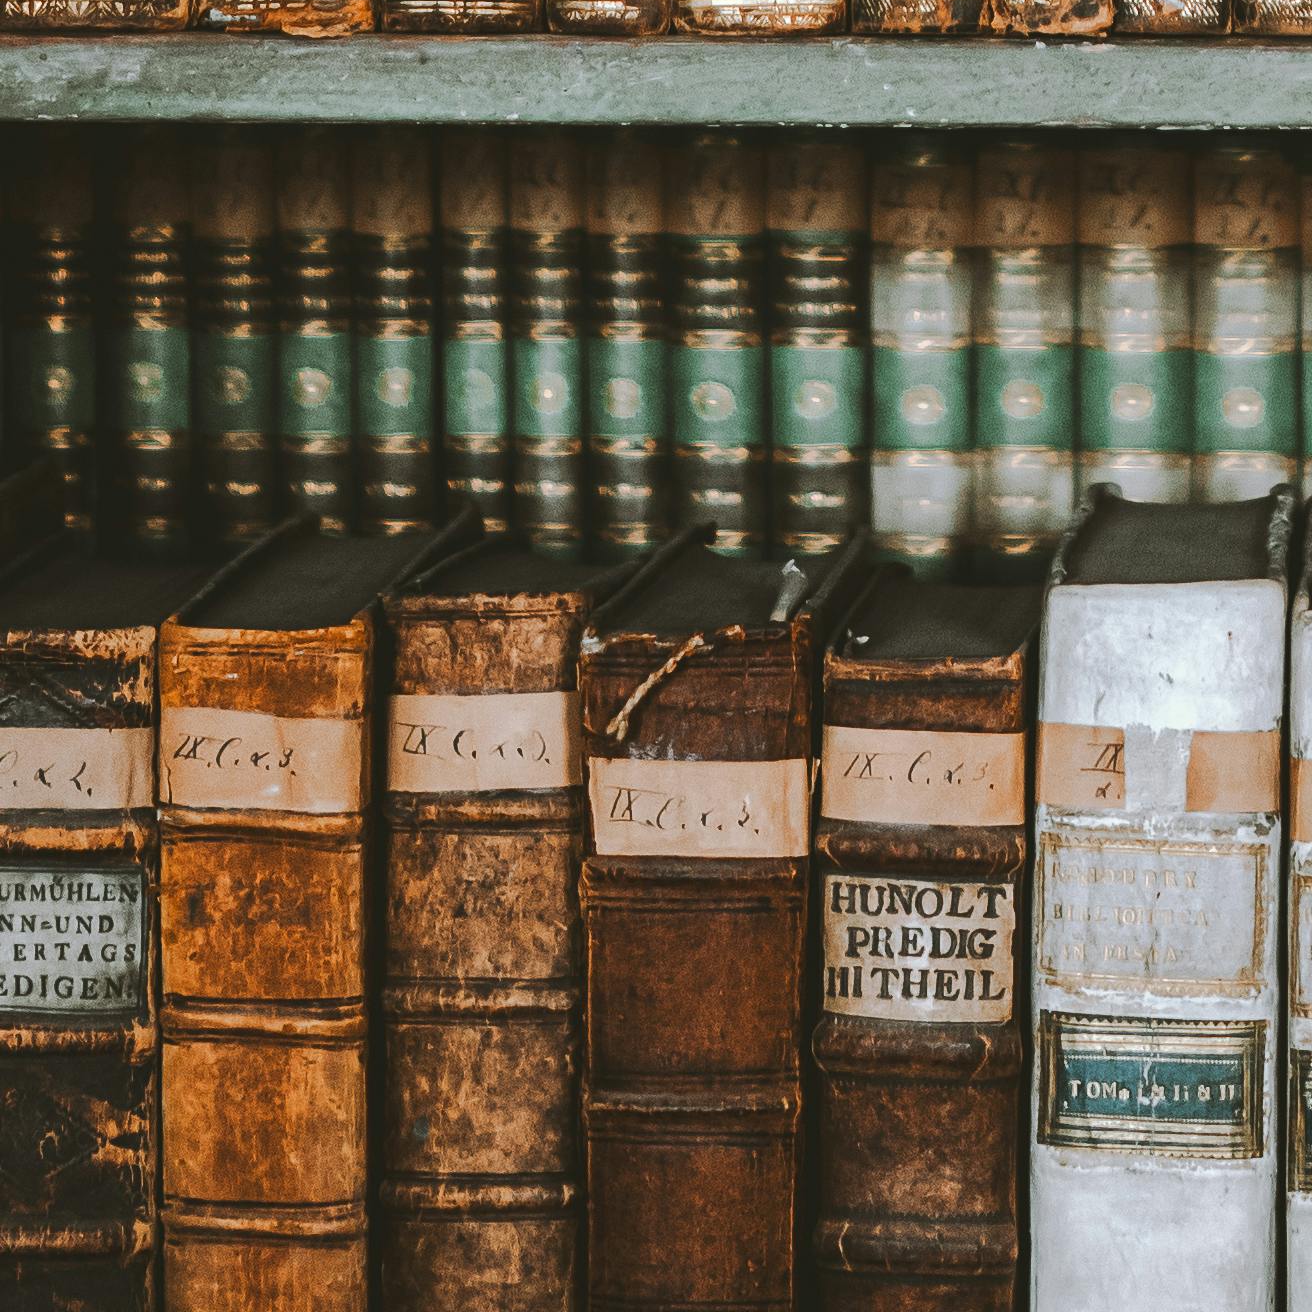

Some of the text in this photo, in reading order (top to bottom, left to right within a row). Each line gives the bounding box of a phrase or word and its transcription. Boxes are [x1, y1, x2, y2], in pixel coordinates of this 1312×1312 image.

[830, 881, 1007, 920] HUNOLT
[844, 927, 997, 960] PREDIG
[869, 967, 1007, 1002] THEIL
